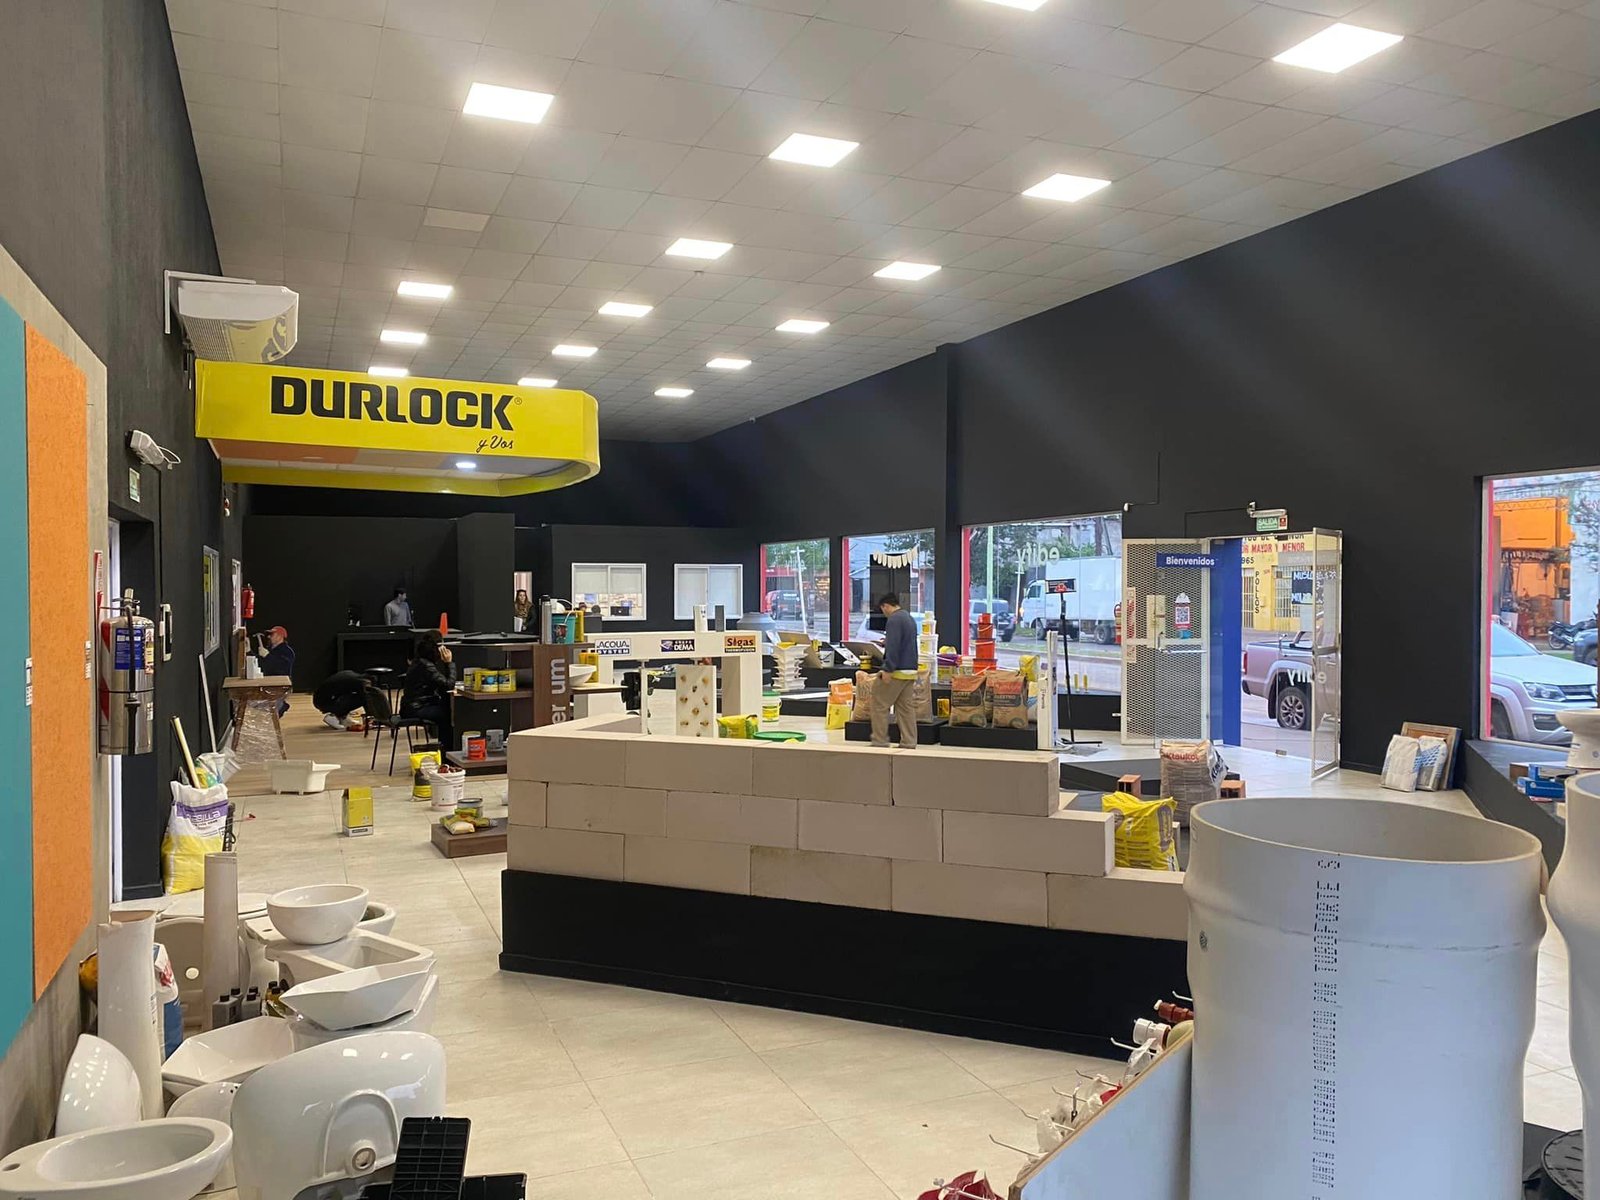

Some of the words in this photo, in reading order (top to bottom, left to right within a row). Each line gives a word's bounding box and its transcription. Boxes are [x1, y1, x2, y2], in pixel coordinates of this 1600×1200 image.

[271, 375, 514, 431] DURLOCK
[476, 437, 488, 454] y
[490, 435, 514, 449] Vos
[1282, 542, 1305, 552] MENOR
[1166, 556, 1215, 565] Bienvenidos
[599, 640, 628, 648] ACQUA
[727, 637, 754, 649] Sigas
[1313, 880, 1340, 972] TUBOFORTE
